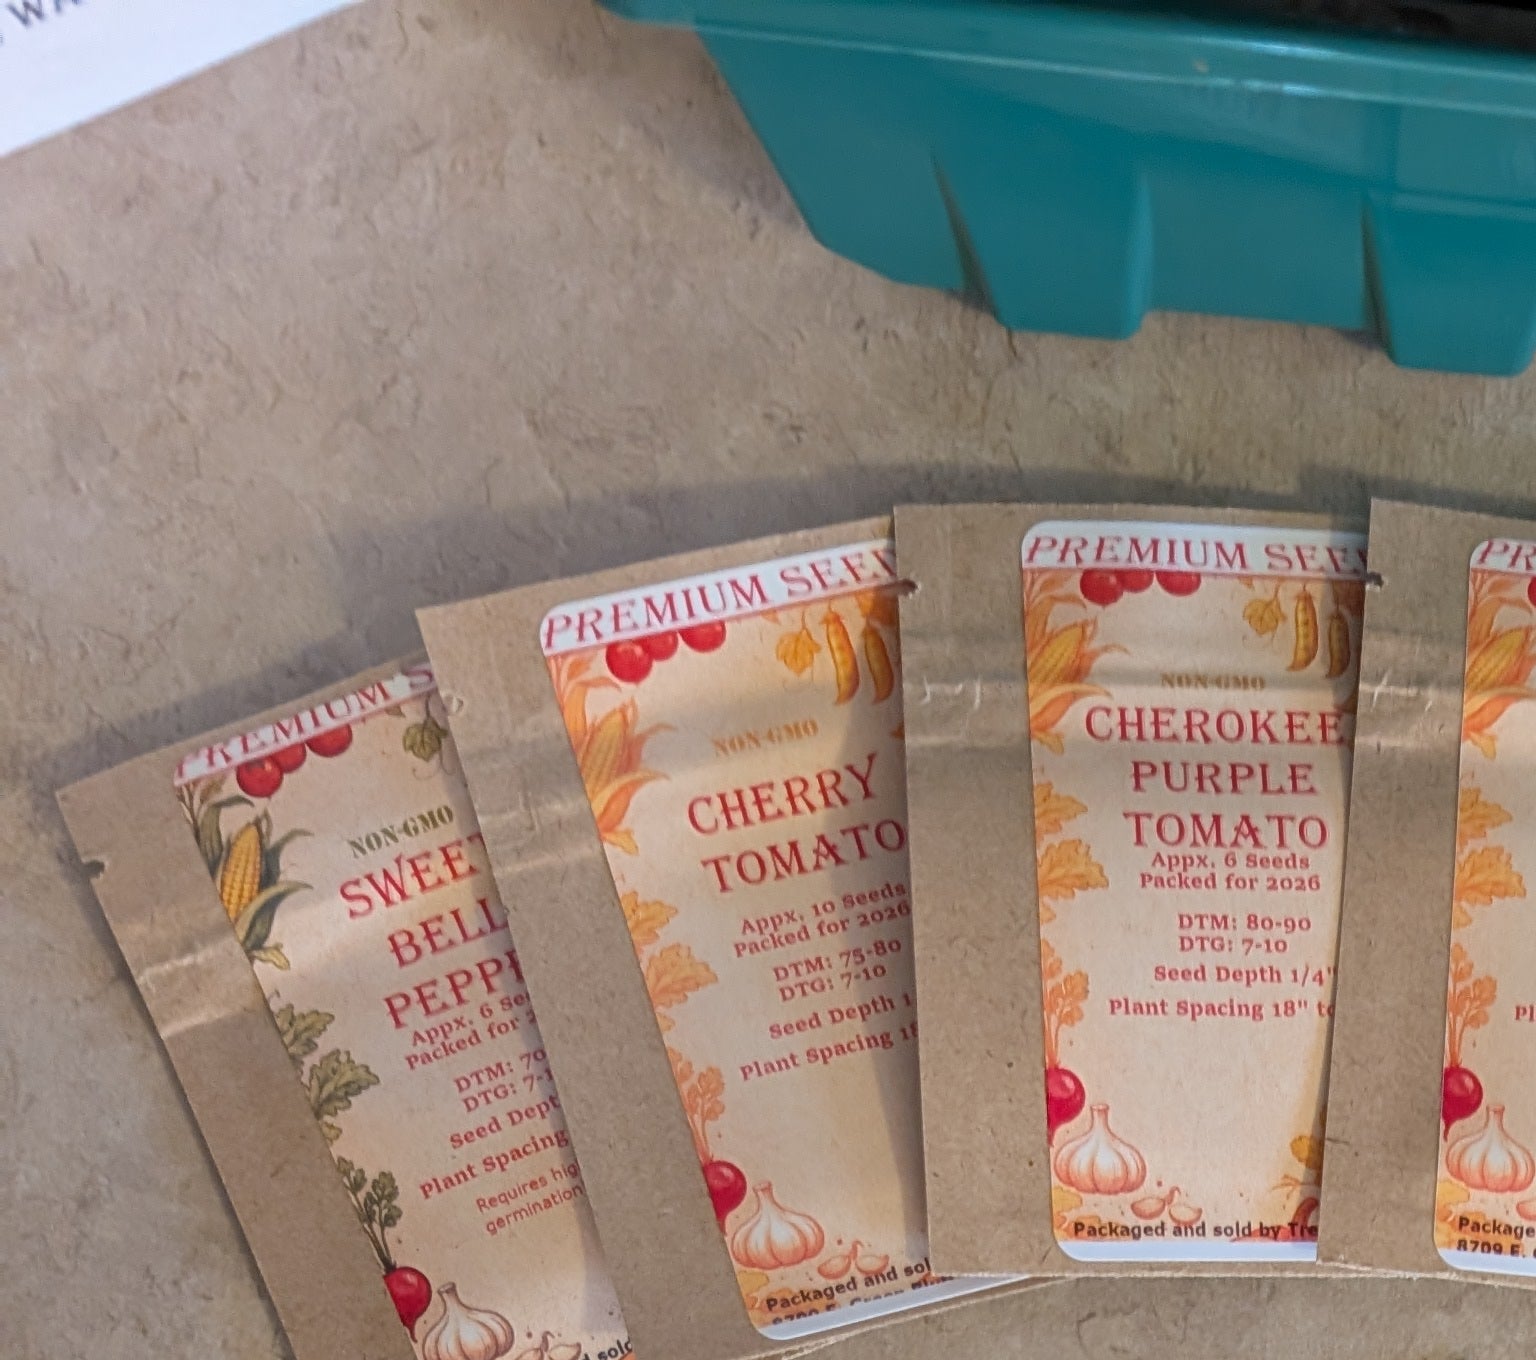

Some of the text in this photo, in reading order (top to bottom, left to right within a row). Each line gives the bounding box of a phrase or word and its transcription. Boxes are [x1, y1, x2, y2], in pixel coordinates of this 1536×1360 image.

[711, 718, 819, 757] NON-GMO
[1086, 706, 1347, 747] CHEROKEE
[687, 753, 875, 835] CHERRY
[1131, 760, 1317, 795] PURPLE
[347, 805, 454, 859] NON-GMO
[1122, 812, 1328, 849] TOMATO
[700, 820, 906, 894] TOMATO
[1151, 851, 1310, 873] Appx. 6 Seeds
[1140, 871, 1321, 892] Packed for 2026
[741, 882, 907, 936] Appx. 10 Seeds
[1178, 913, 1311, 935] DTM: 80-90
[387, 898, 510, 968] BELL
[1178, 935, 1288, 956] DTG: 7-10
[772, 939, 902, 982] DTM: 75-80
[383, 947, 525, 1030] PEPP
[778, 964, 887, 1003] DTG: 7-10
[404, 1017, 520, 1071] Packed for
[453, 1043, 551, 1094] DTM: 70
[419, 1121, 576, 1200] Plant Spacing
